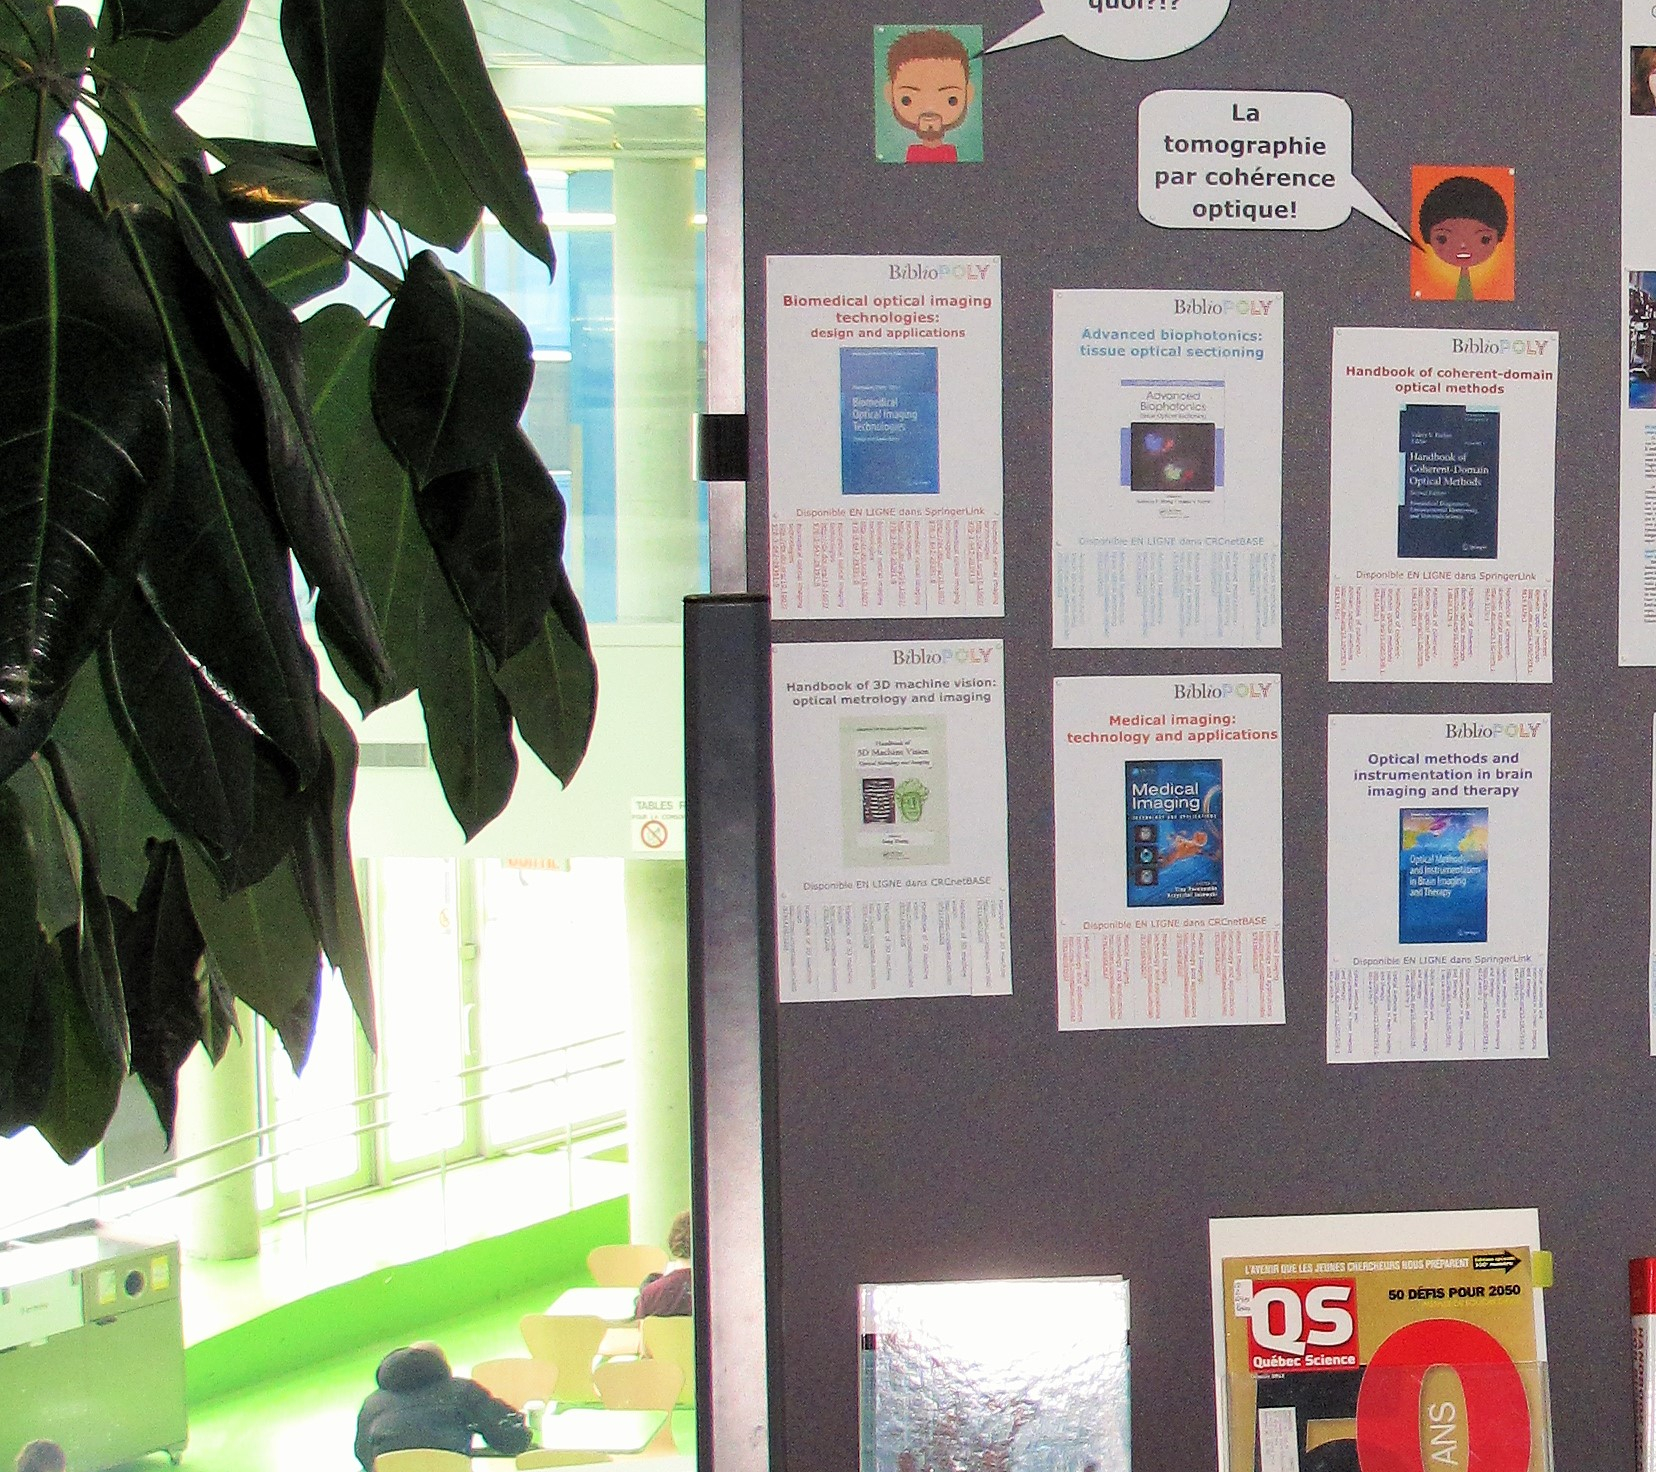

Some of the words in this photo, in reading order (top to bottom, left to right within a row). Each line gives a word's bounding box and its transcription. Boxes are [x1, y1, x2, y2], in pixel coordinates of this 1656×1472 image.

[1232, 104, 1260, 123] La
[1163, 134, 1327, 159] tomographie
[1154, 168, 1197, 189] par
[1205, 166, 1336, 188] cohérence
[1192, 199, 1298, 222] optique!
[783, 295, 867, 307] Biomedical
[873, 295, 924, 310] optical
[930, 294, 992, 309] imaging
[836, 311, 939, 325] technologies:
[811, 328, 853, 340] design
[859, 328, 882, 338] and
[887, 327, 965, 340] applications
[1081, 328, 1155, 341] Advanced
[1161, 329, 1263, 346] biophotonics:
[1079, 345, 1125, 357] tissue
[1131, 345, 1181, 360] optical
[1187, 346, 1264, 361] sectioning
[1346, 366, 1415, 377] Handbook
[1420, 366, 1433, 377] of
[1437, 367, 1553, 380] coherent-domain
[1395, 382, 1440, 395] optical
[1446, 383, 1504, 394] methods
[850, 508, 863, 517] EN
[866, 508, 896, 517] LIGNE
[1407, 571, 1420, 579] EN
[1423, 571, 1451, 580] LIGNE
[787, 681, 852, 692] Handbook
[856, 680, 869, 690] of
[873, 680, 890, 689] 3D
[895, 679, 950, 689] machine
[954, 678, 997, 688] vision:
[793, 695, 836, 706] optical
[841, 694, 907, 706] metrology
[911, 693, 935, 703] and
[940, 692, 991, 703] imaging
[1109, 714, 1165, 726] Medical
[1171, 714, 1236, 727] imaging:
[1067, 731, 1150, 745] technology
[1155, 730, 1183, 742] and
[1188, 729, 1278, 743] applications
[1368, 753, 1419, 766] Optical
[1425, 753, 1488, 764] methods
[1493, 753, 1519, 763] and
[1354, 769, 1473, 780] instrumentation
[1477, 769, 1491, 780] in
[1496, 768, 1533, 779] brain
[1132, 782, 1198, 796] Medical
[1368, 785, 1426, 798] imaging
[1432, 785, 1458, 796] and
[1464, 785, 1519, 798] therapy
[636, 801, 673, 810] TABLES
[1132, 797, 1200, 812] Imaging
[856, 880, 869, 889] EN
[873, 879, 901, 888] LIGNE
[1419, 956, 1447, 964] LIGNE
[1299, 1263, 1313, 1273] LES
[1388, 1288, 1404, 1300] 50
[1408, 1285, 1445, 1300] DÉFIS
[1449, 1286, 1485, 1298] POUR
[1489, 1284, 1521, 1297] 2050
[1251, 1285, 1354, 1356] QS
[1253, 1355, 1301, 1369] Québec
[1305, 1355, 1355, 1366] Science
[1428, 1400, 1459, 1468] ANS
